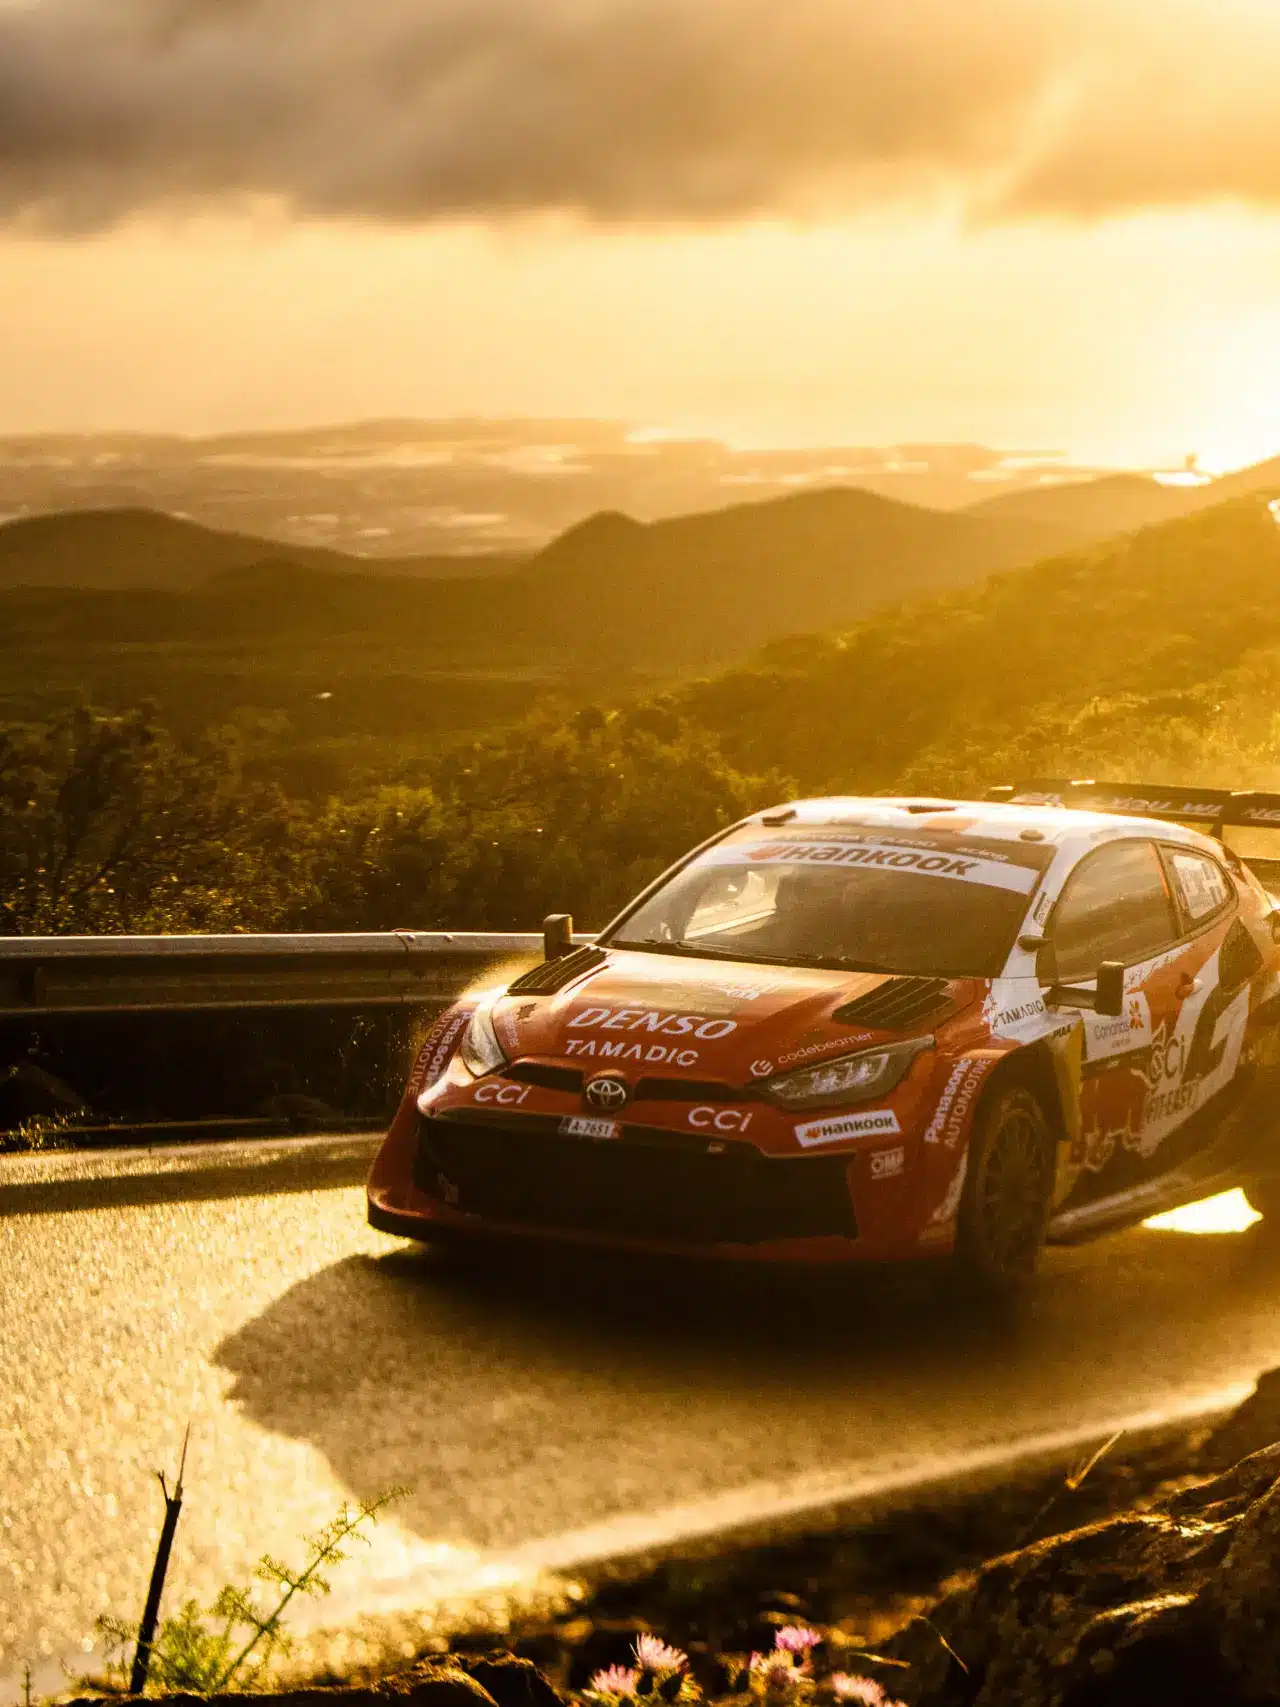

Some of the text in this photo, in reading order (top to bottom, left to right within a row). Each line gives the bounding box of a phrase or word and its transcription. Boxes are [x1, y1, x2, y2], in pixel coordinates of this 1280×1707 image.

[567, 1007, 738, 1040] DENSO
[998, 999, 1045, 1027] TAMADIC
[407, 1010, 457, 1097] UTOMOTIVE
[565, 1039, 699, 1067] TAMADIC
[777, 1031, 874, 1065] codebeamer
[923, 1057, 973, 1144] Panasonic
[943, 1056, 993, 1148] AUTOMOTIVE
